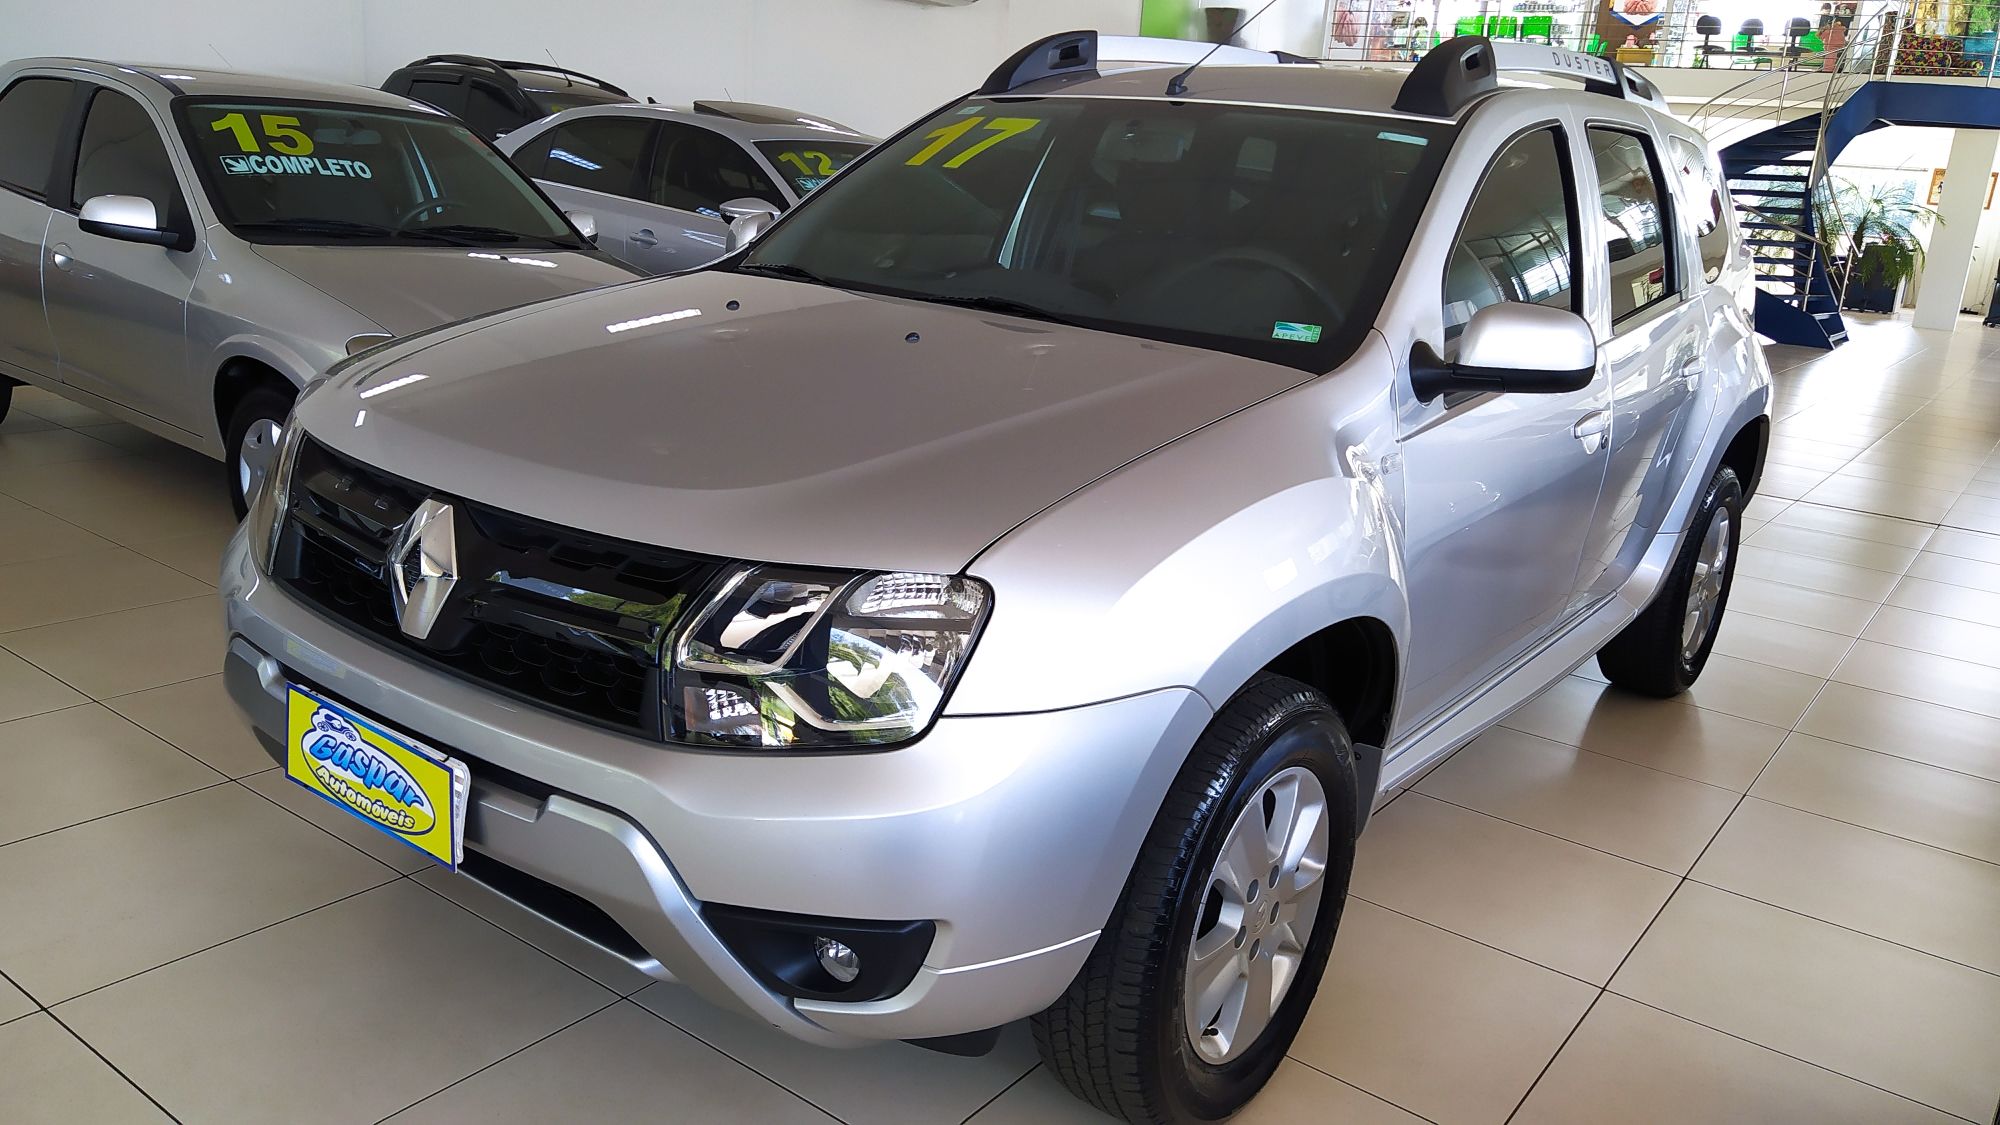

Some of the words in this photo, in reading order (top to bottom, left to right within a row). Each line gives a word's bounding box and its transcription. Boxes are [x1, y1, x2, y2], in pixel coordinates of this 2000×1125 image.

[1552, 52, 1611, 77] DUSTER
[211, 113, 314, 156] 15
[904, 116, 1041, 168] 17
[249, 155, 372, 179] COMPLETO
[778, 151, 838, 176] 12
[315, 765, 415, 829] Automóveis
